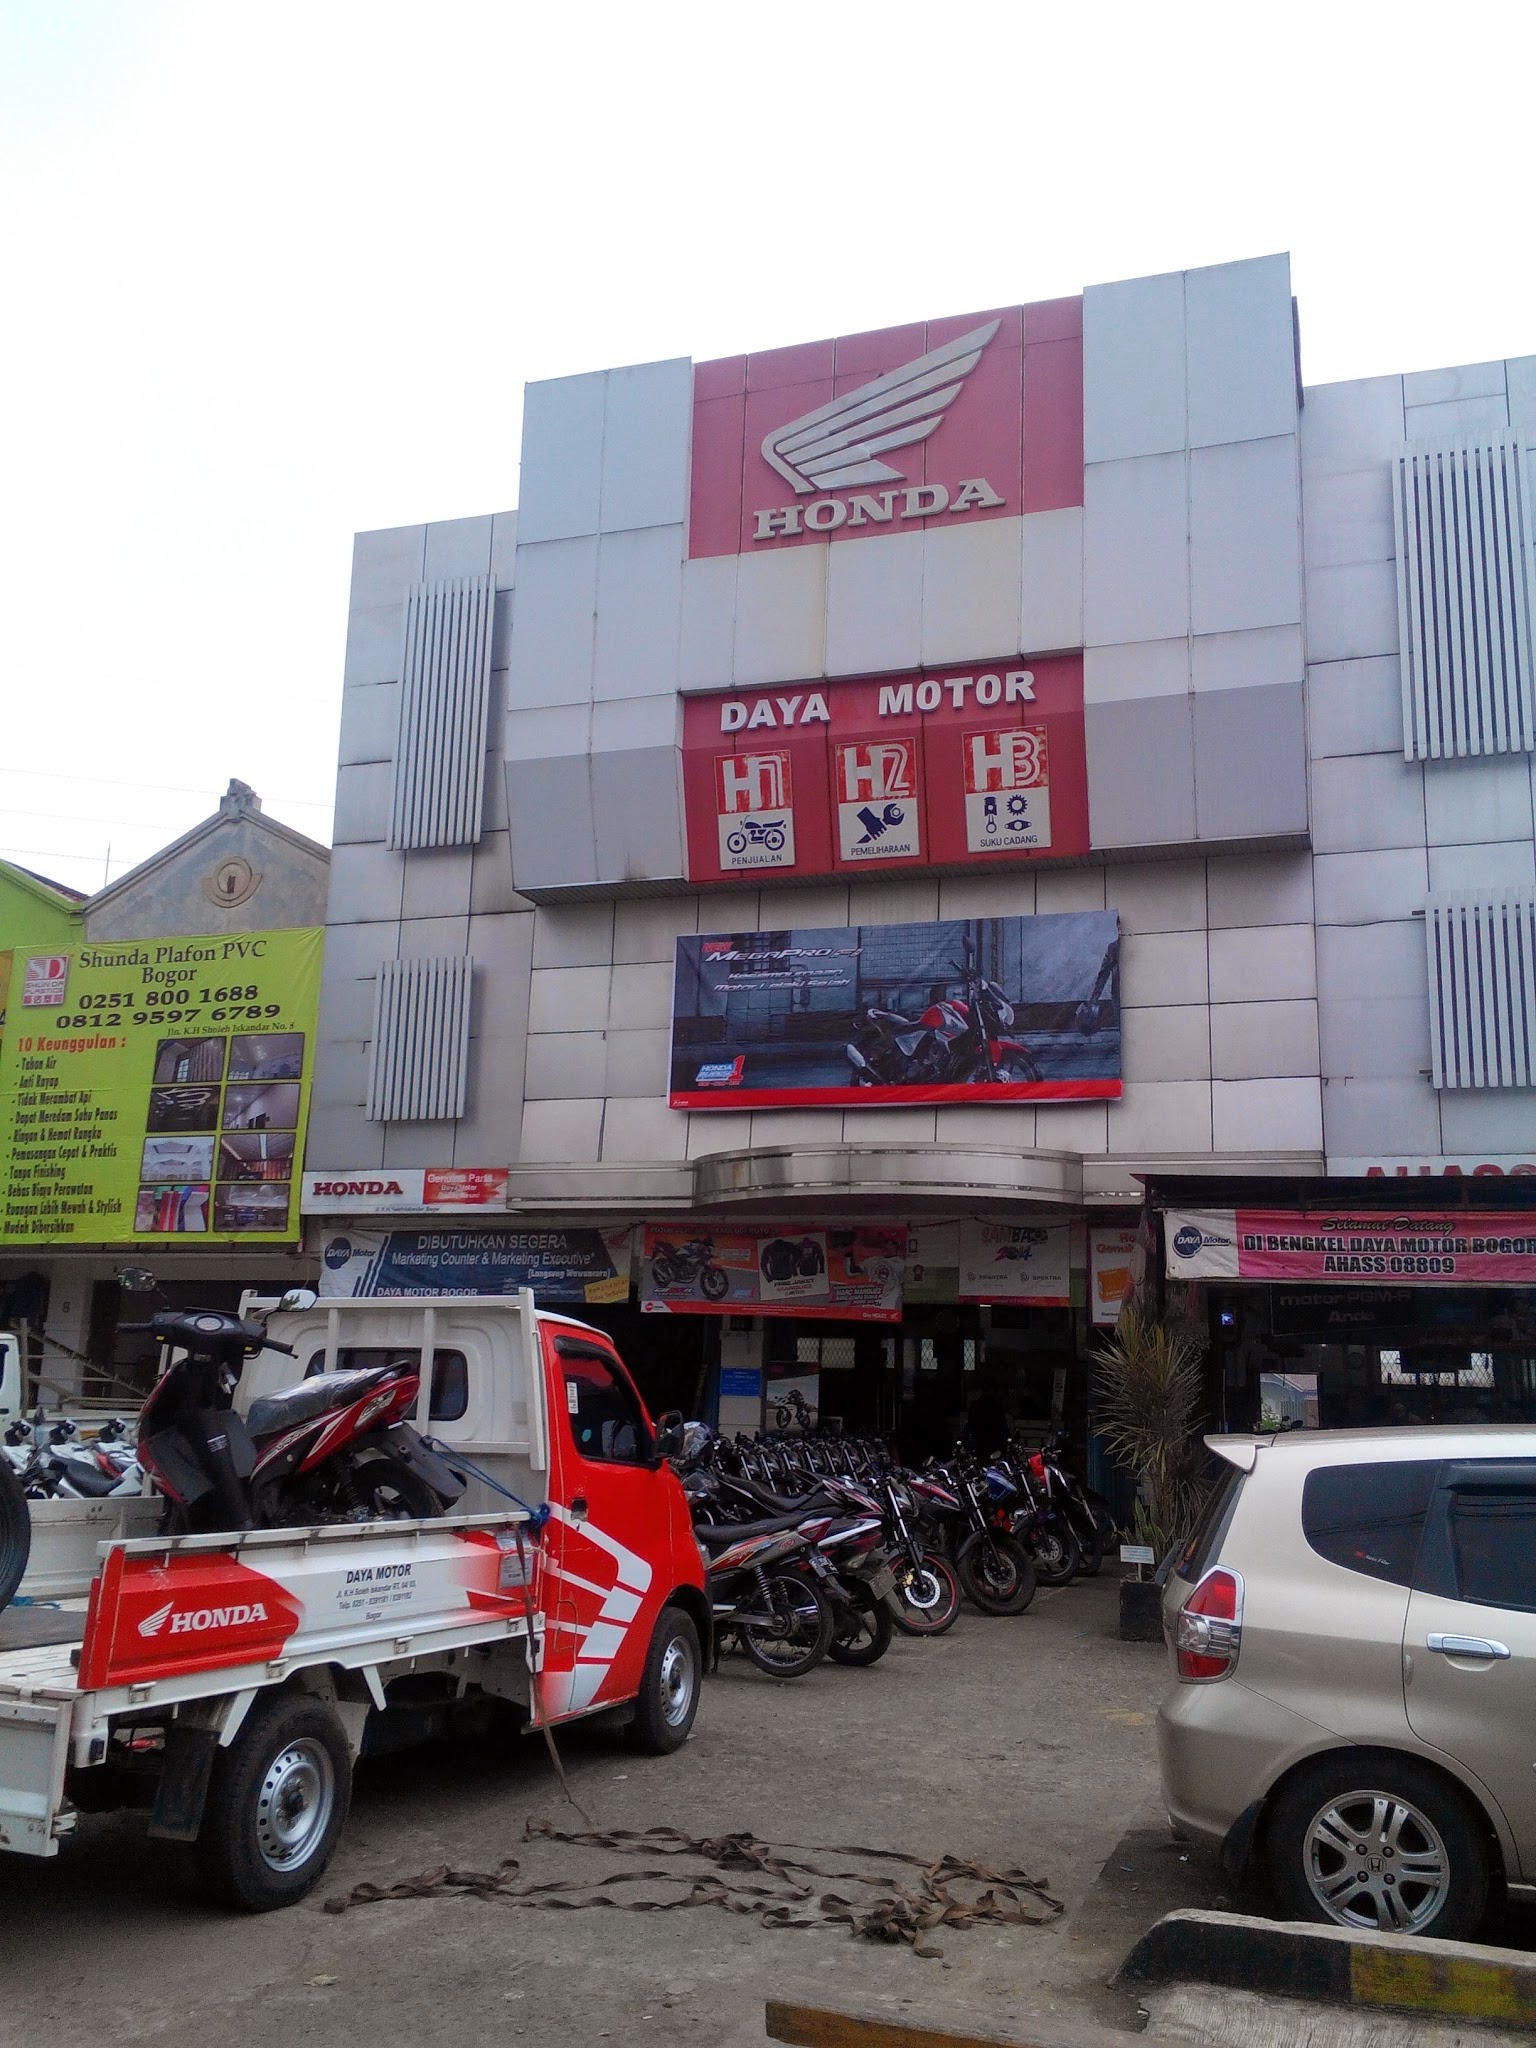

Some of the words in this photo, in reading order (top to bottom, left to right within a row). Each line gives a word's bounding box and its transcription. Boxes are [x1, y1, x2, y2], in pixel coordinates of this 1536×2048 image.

[752, 477, 1006, 540] HONDA
[720, 693, 830, 733] DAYA
[878, 670, 1036, 718] MOTOR
[843, 743, 910, 801] H2
[850, 843, 911, 857] PEMELIHARAAN
[980, 837, 1001, 847] SUKU
[1003, 835, 1038, 845] CADANG
[731, 854, 783, 865] PENJUALAN
[79, 948, 149, 969] Shunda
[154, 944, 216, 964] Plafon
[221, 940, 267, 960] PVC
[141, 967, 197, 988] Bogor
[713, 983, 759, 993] Motor
[758, 980, 805, 991] Lelaki
[806, 978, 852, 990] Sejati
[78, 992, 136, 1010] 0251
[145, 989, 190, 1006] 800
[199, 984, 259, 1003] 1688
[56, 1013, 122, 1029] 0812
[132, 1008, 201, 1026] 9597
[211, 1004, 281, 1022] 6789
[18, 1037, 33, 1053] 10
[36, 1033, 117, 1053] Keunggulan
[22, 1056, 43, 1070] Tahan
[45, 1055, 57, 1069] Air
[701, 1064, 734, 1072] HONDA
[19, 1074, 35, 1088] Anti
[36, 1075, 59, 1089] Rayap
[18, 1092, 37, 1106] Tidak
[94, 1107, 118, 1120] Panas
[11, 1147, 57, 1162] Pemasangan
[58, 1145, 80, 1161] Cepat
[89, 1143, 118, 1158] Praktis
[10, 1165, 32, 1181] Tanpa
[33, 1163, 67, 1180] Finishing
[7, 1184, 31, 1197] Bebas
[53, 1182, 94, 1196] Perawatan
[312, 1181, 403, 1197] HONDA
[39, 1200, 59, 1215] Lebih
[60, 1199, 87, 1214] Mewah
[96, 1197, 122, 1216] Stylish
[1322, 1217, 1388, 1232] Selamat
[1392, 1217, 1455, 1235] Datang
[417, 1235, 506, 1249] DIBUTUHKAN
[509, 1234, 568, 1249] SEGERA
[1243, 1235, 1262, 1251] DI
[1265, 1235, 1348, 1253] BENGKEL
[1350, 1237, 1397, 1254] DAYA
[1400, 1237, 1468, 1255] MOTOR
[1471, 1237, 1536, 1256] BOGOR
[326, 1249, 350, 1258] DAYA
[351, 1248, 377, 1257] Motor
[391, 1252, 438, 1268] Marketing
[440, 1252, 479, 1266] Counter
[481, 1252, 490, 1265] &
[491, 1252, 540, 1267] Marketing
[1323, 1255, 1386, 1274] AHASS
[1390, 1256, 1456, 1274] 08809
[376, 1287, 401, 1296] DAYA
[404, 1287, 439, 1296] MOTOR
[441, 1287, 478, 1296] BOGOR
[346, 1568, 373, 1583] DAYA
[375, 1564, 412, 1579] MOTOR
[169, 1603, 268, 1634] HONDA
